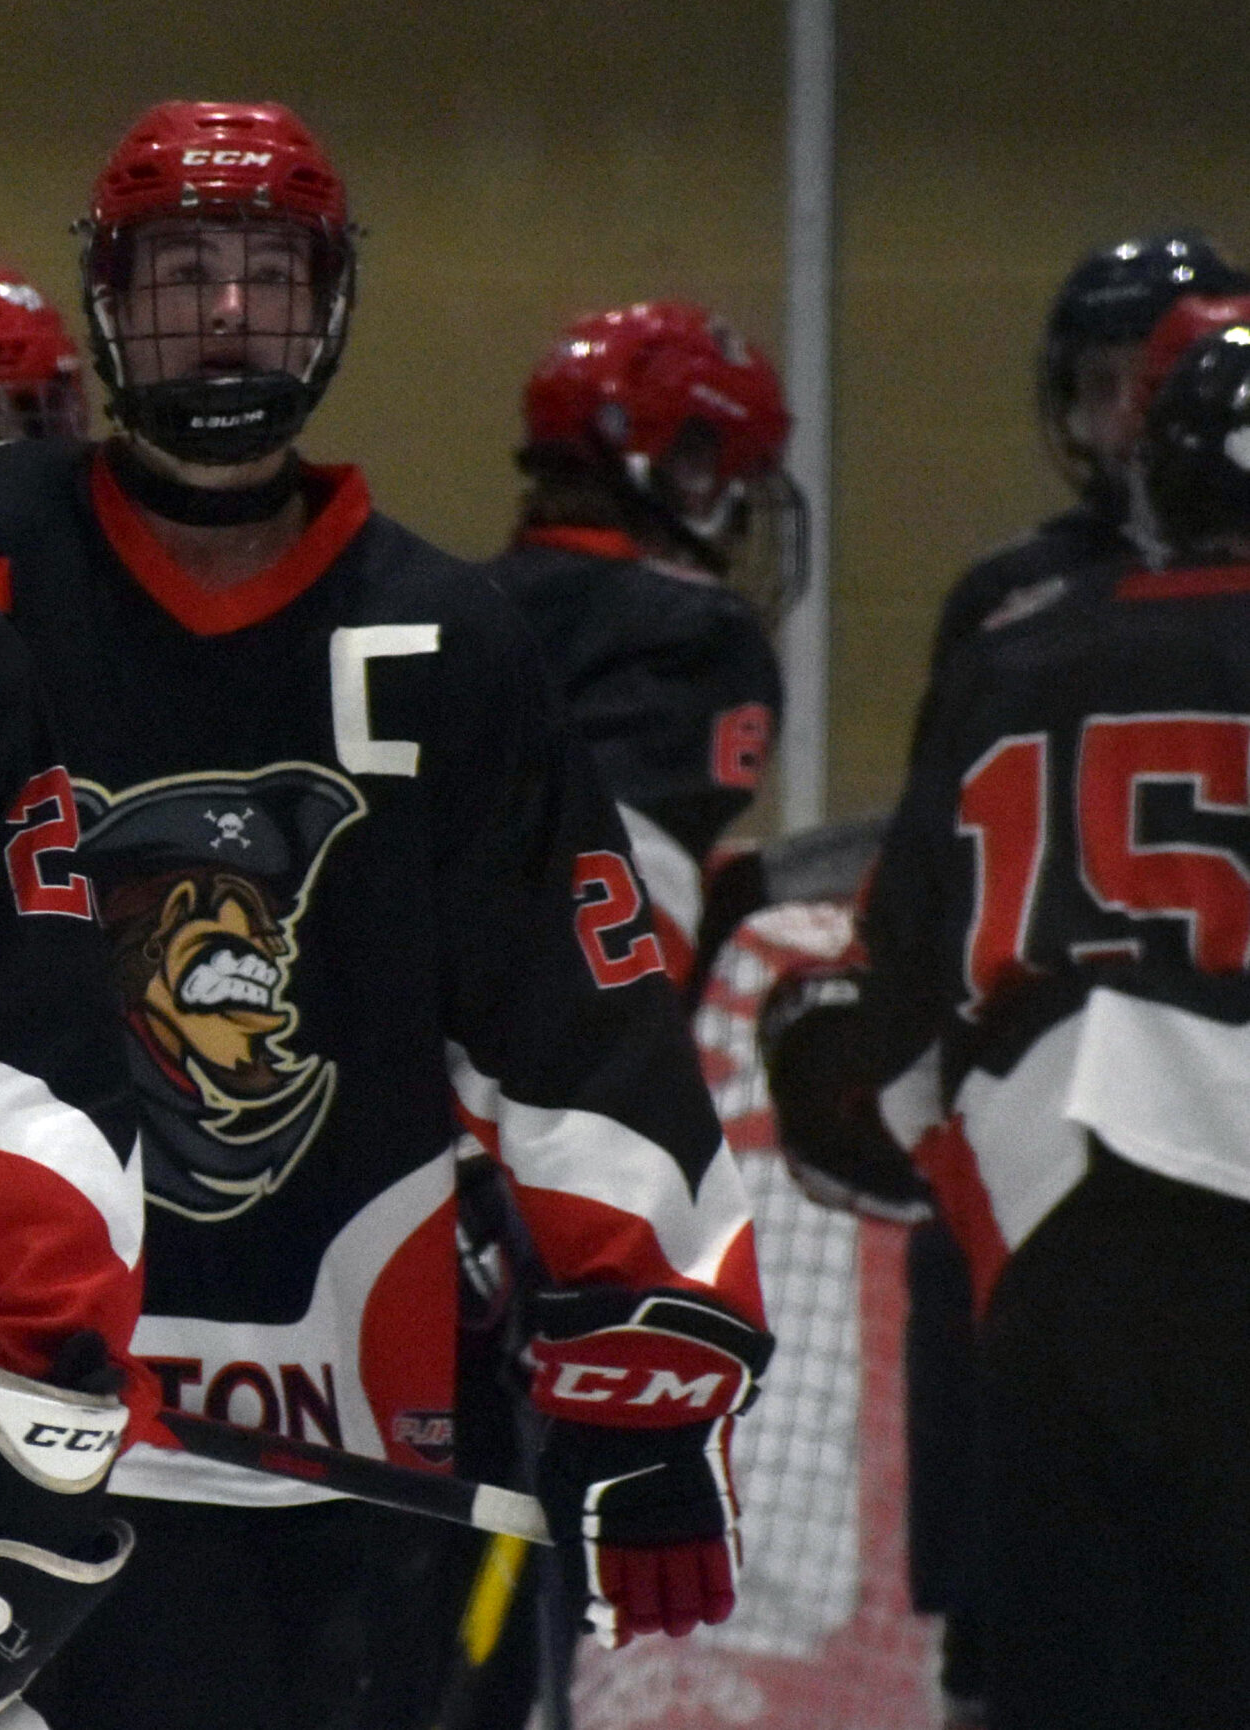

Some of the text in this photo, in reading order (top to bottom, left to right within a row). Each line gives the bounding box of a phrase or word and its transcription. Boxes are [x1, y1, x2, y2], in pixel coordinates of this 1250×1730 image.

[182, 150, 272, 167] CCM
[329, 624, 441, 777] C
[4, 765, 93, 920] 2
[955, 712, 1250, 1023] 15
[573, 850, 666, 989] 2
[534, 1352, 726, 1408] CM
